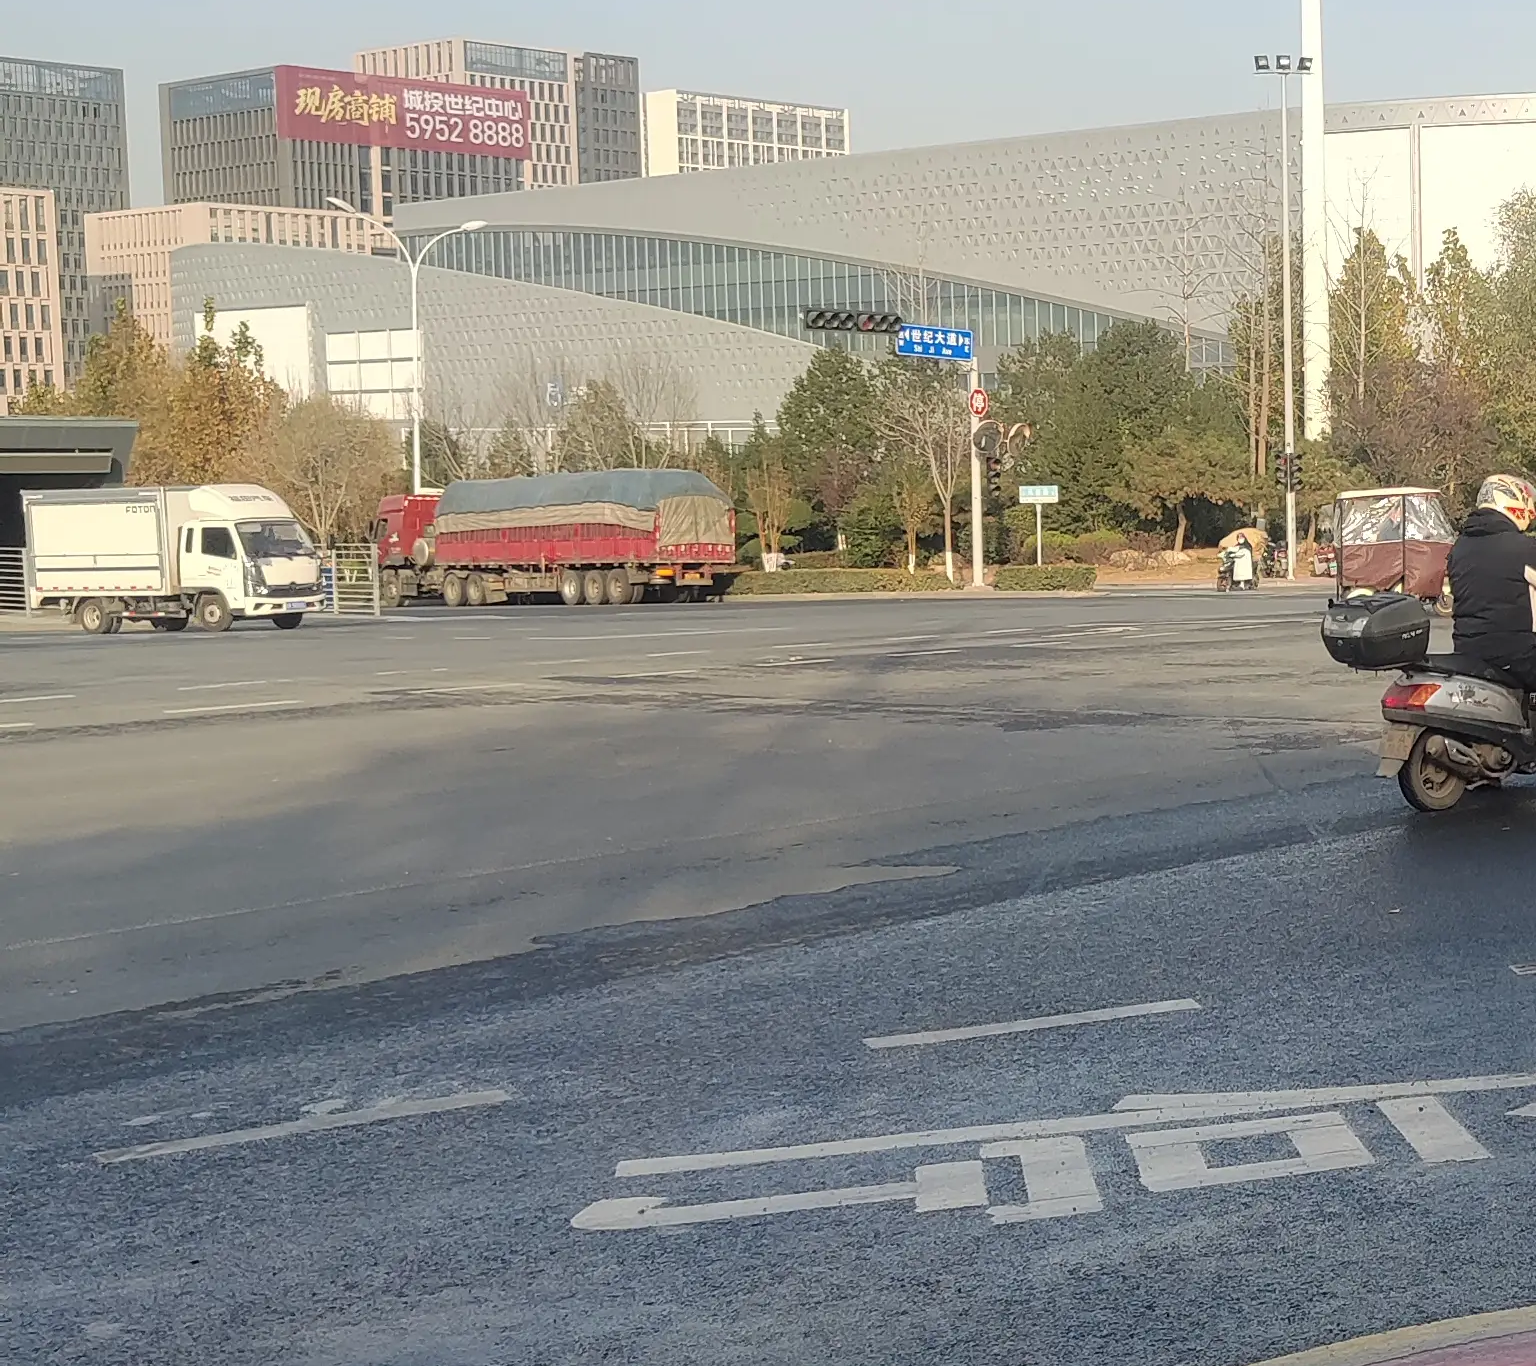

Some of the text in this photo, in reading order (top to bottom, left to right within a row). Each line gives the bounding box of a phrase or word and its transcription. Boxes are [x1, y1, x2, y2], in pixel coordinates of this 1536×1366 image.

[294, 84, 397, 126] 现房商铺
[403, 88, 523, 120] 城投世纪中心
[405, 113, 525, 148] 5952 8888
[911, 329, 957, 346] 世纪大道
[972, 392, 985, 412] 停
[125, 505, 156, 513] FOTON
